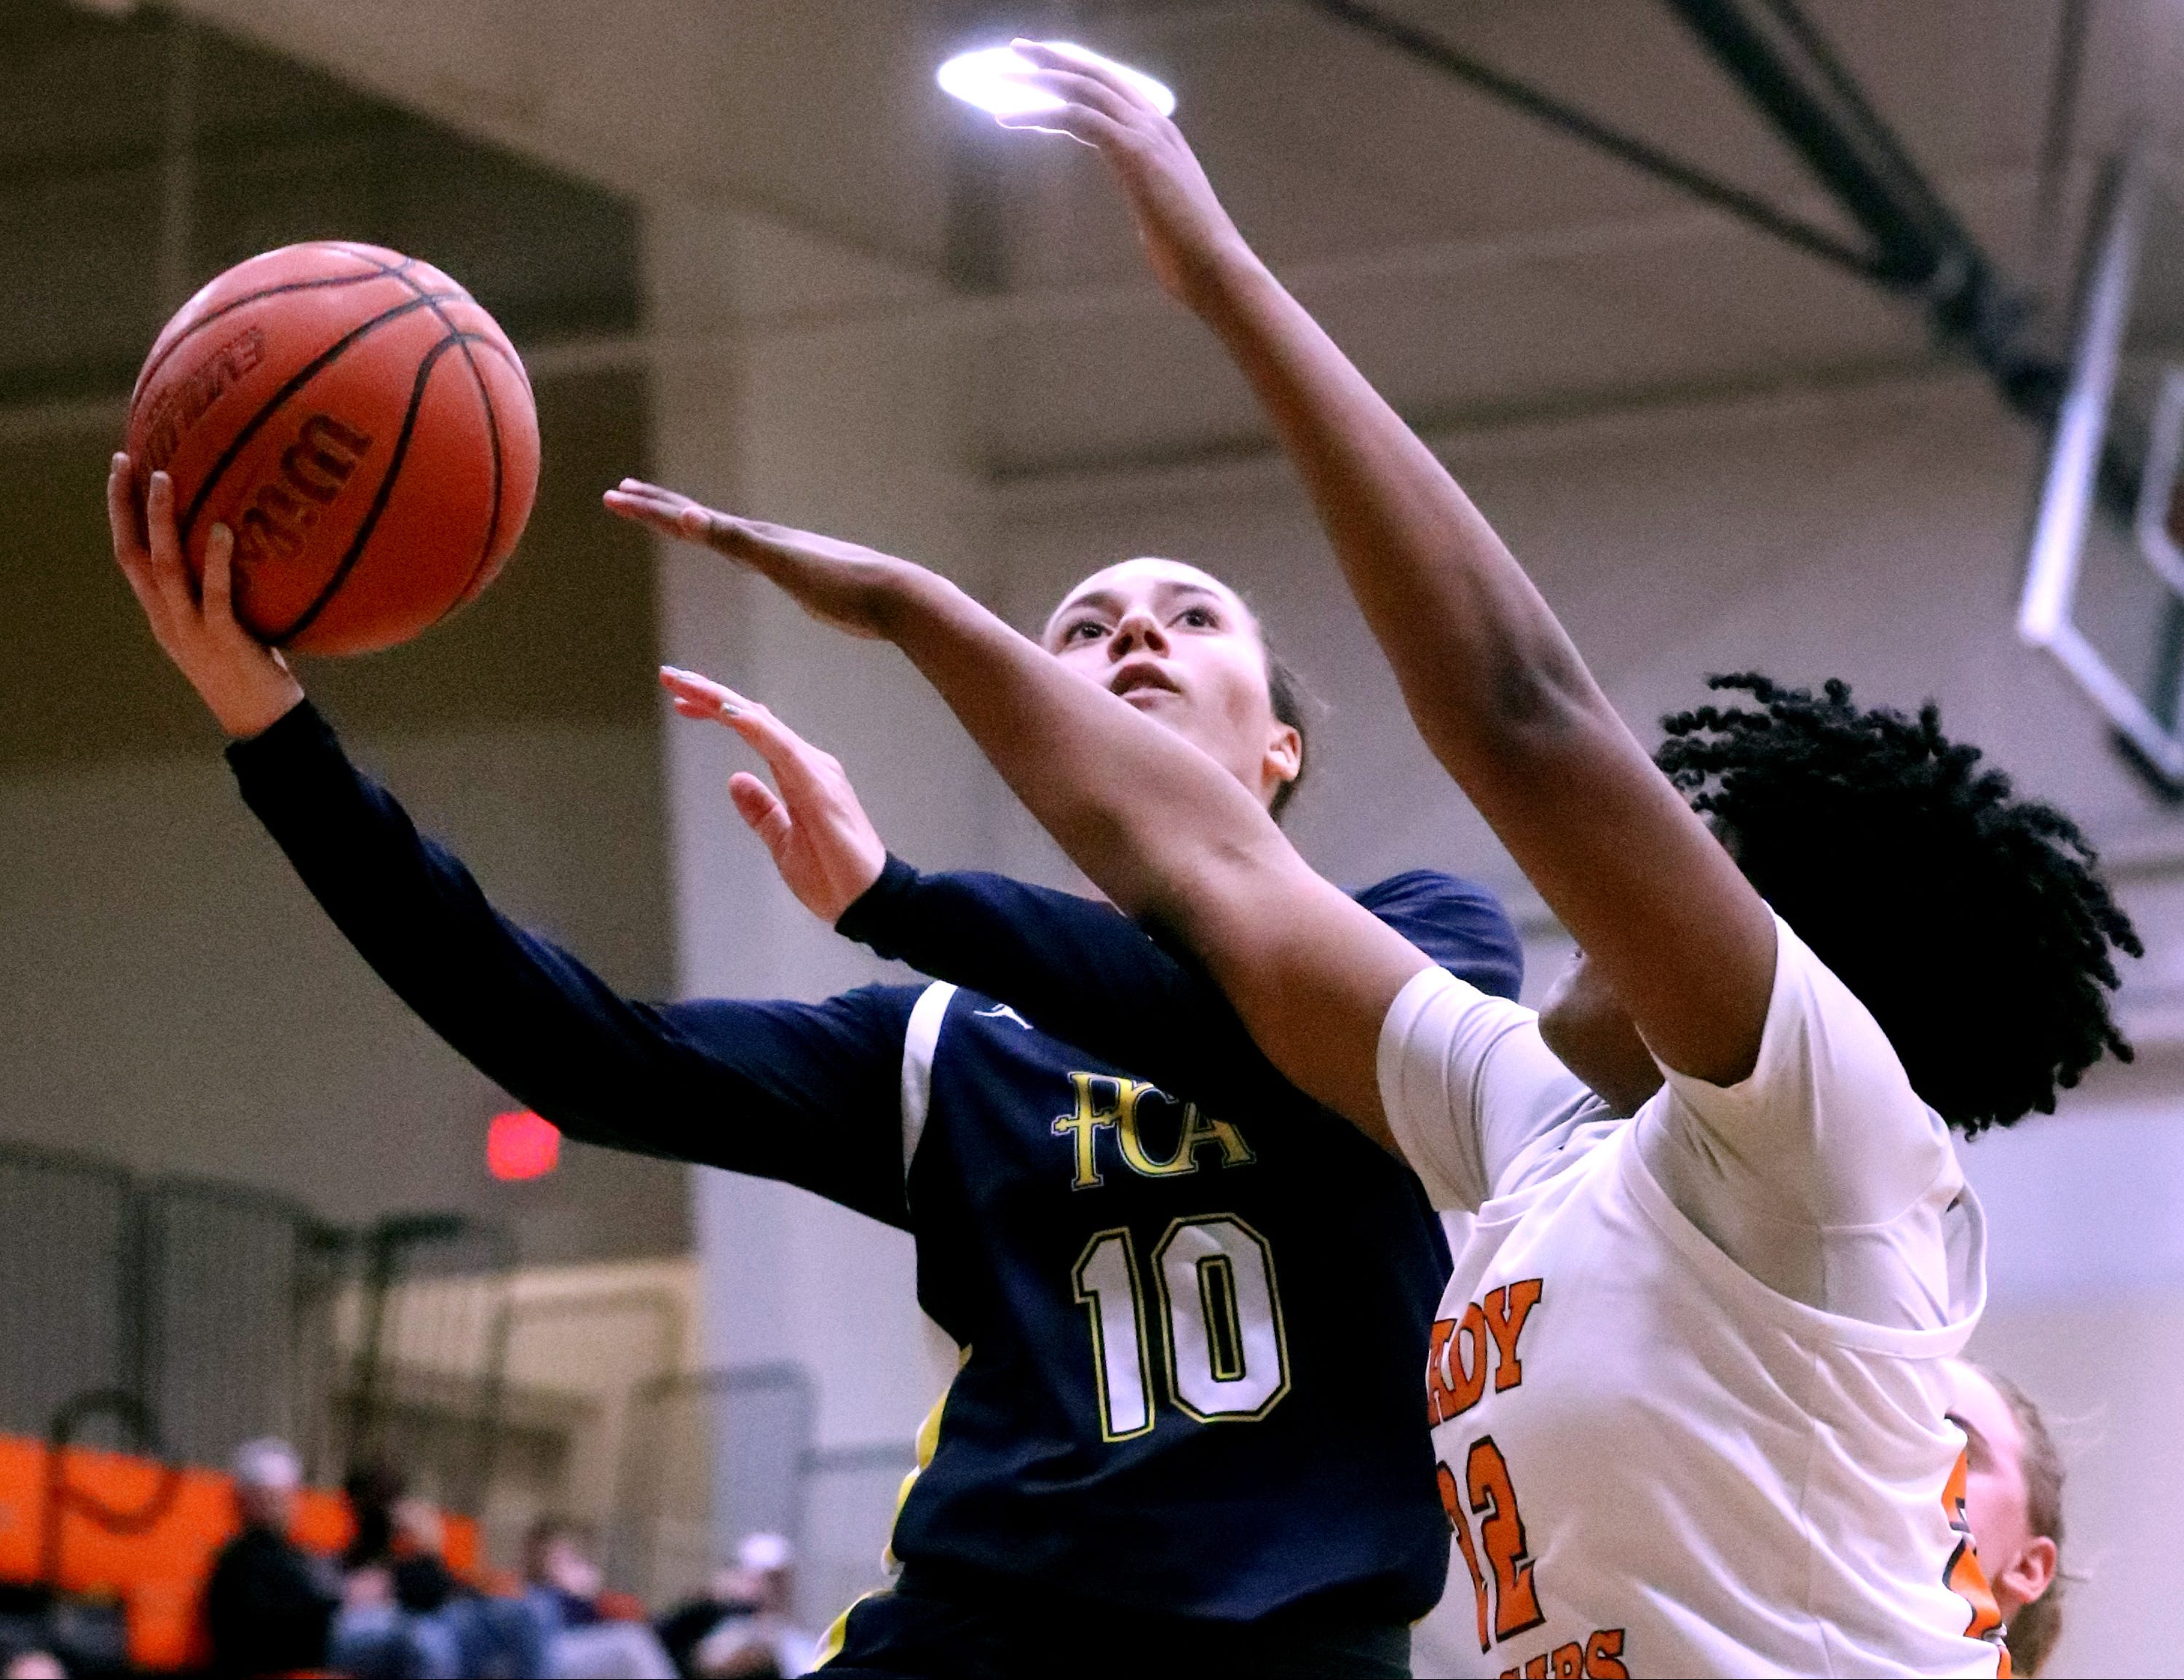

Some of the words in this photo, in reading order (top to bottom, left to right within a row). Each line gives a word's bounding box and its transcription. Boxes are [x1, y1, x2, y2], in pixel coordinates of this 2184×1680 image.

[229, 413, 374, 593] Wils
[1051, 1071, 1257, 1192] PCA
[1071, 1212, 1291, 1443] 10
[1428, 1277, 1544, 1427] ADY
